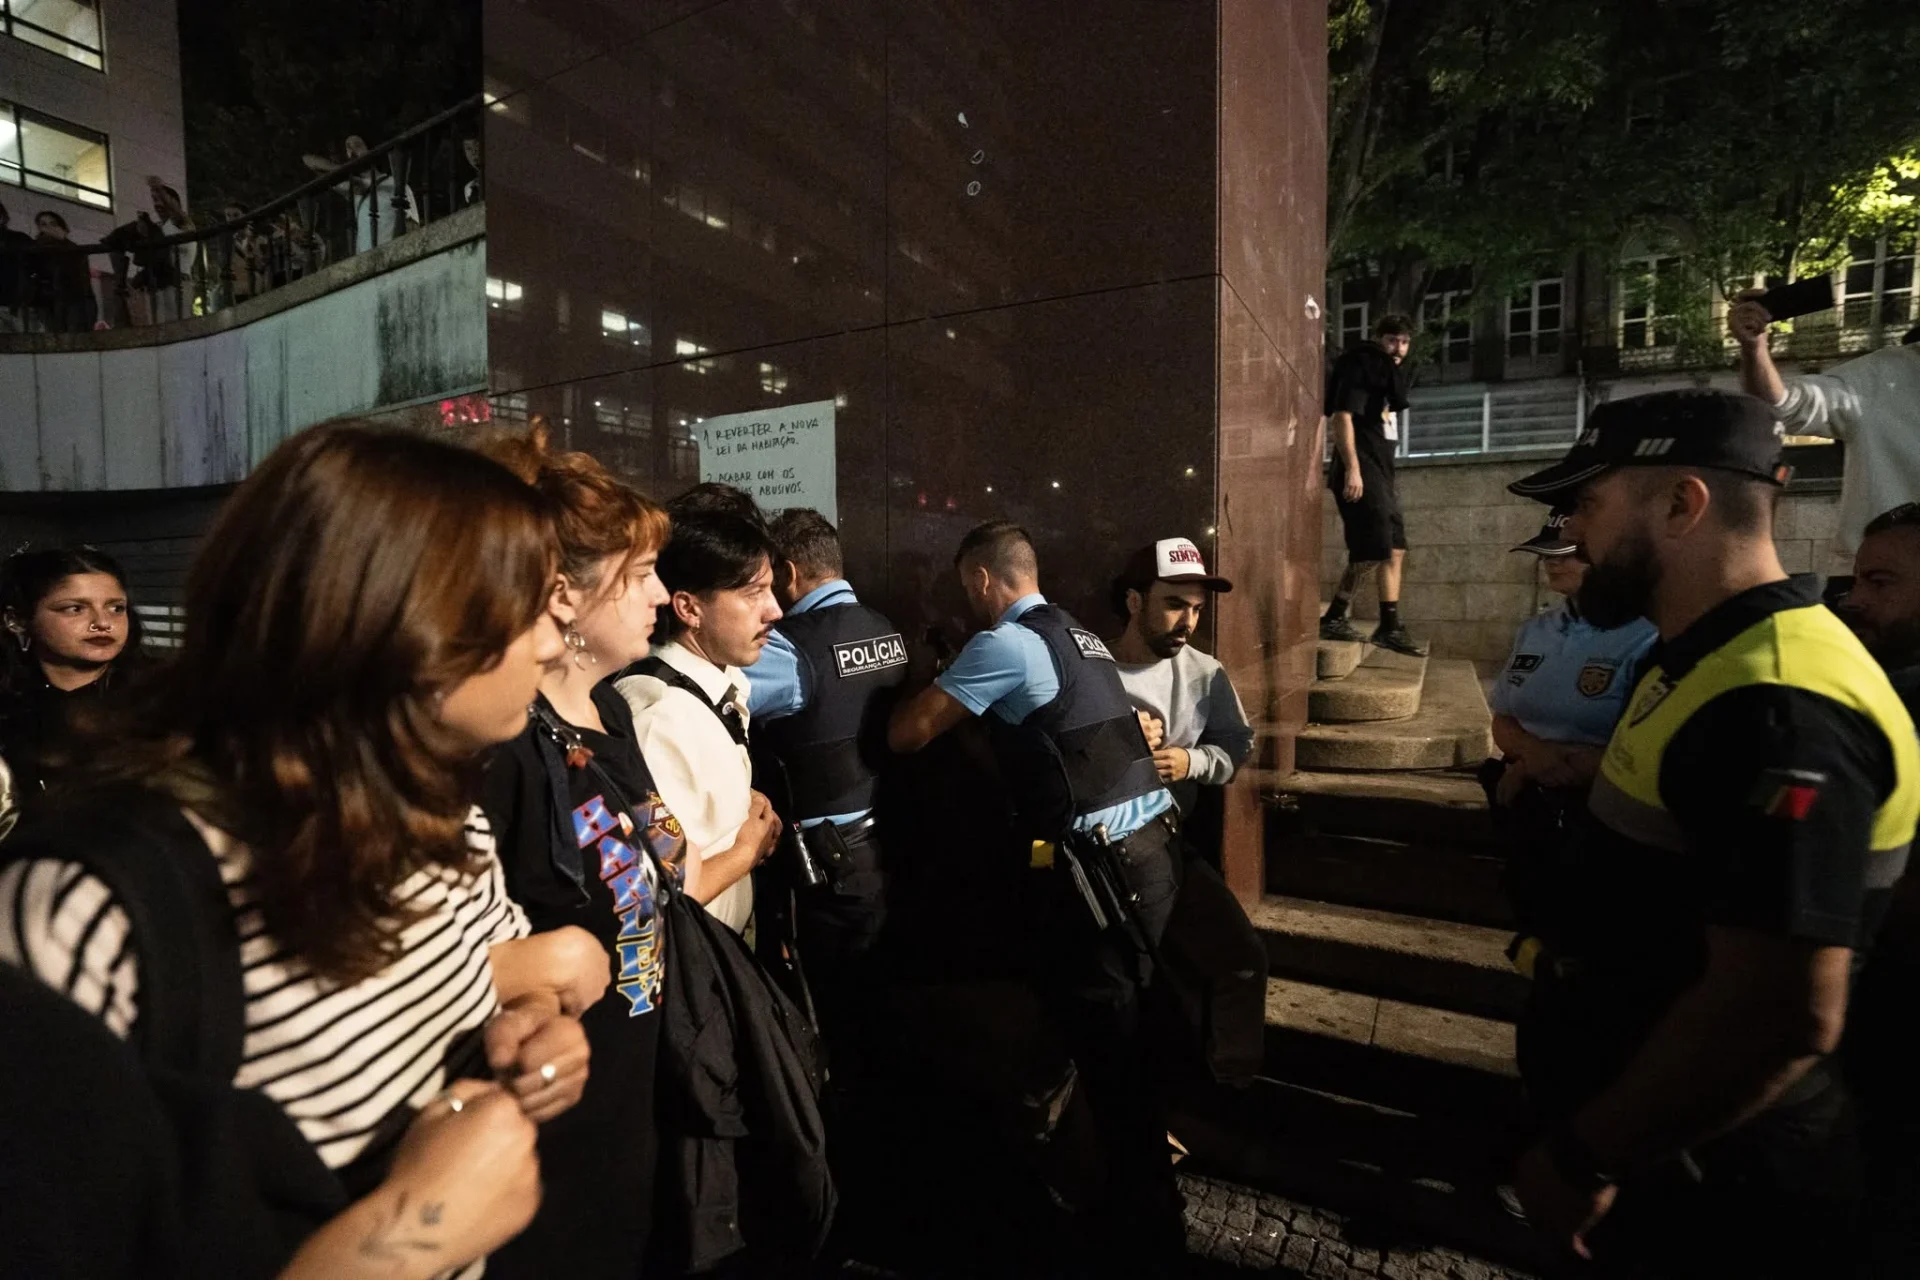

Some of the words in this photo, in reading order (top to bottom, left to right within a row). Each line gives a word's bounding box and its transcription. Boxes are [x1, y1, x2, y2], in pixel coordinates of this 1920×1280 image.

[716, 423, 772, 440] REVERTER
[779, 423, 788, 433] A
[791, 418, 820, 430] NOVA
[716, 440, 731, 456] LEI
[737, 444, 748, 454] DA
[718, 471, 752, 484] ACABAR
[757, 469, 775, 481] COM
[782, 467, 796, 480] OS
[838, 640, 904, 669] POLÍCIA
[842, 662, 882, 674] SEGURANÇA
[572, 795, 656, 1017] HARLEY
